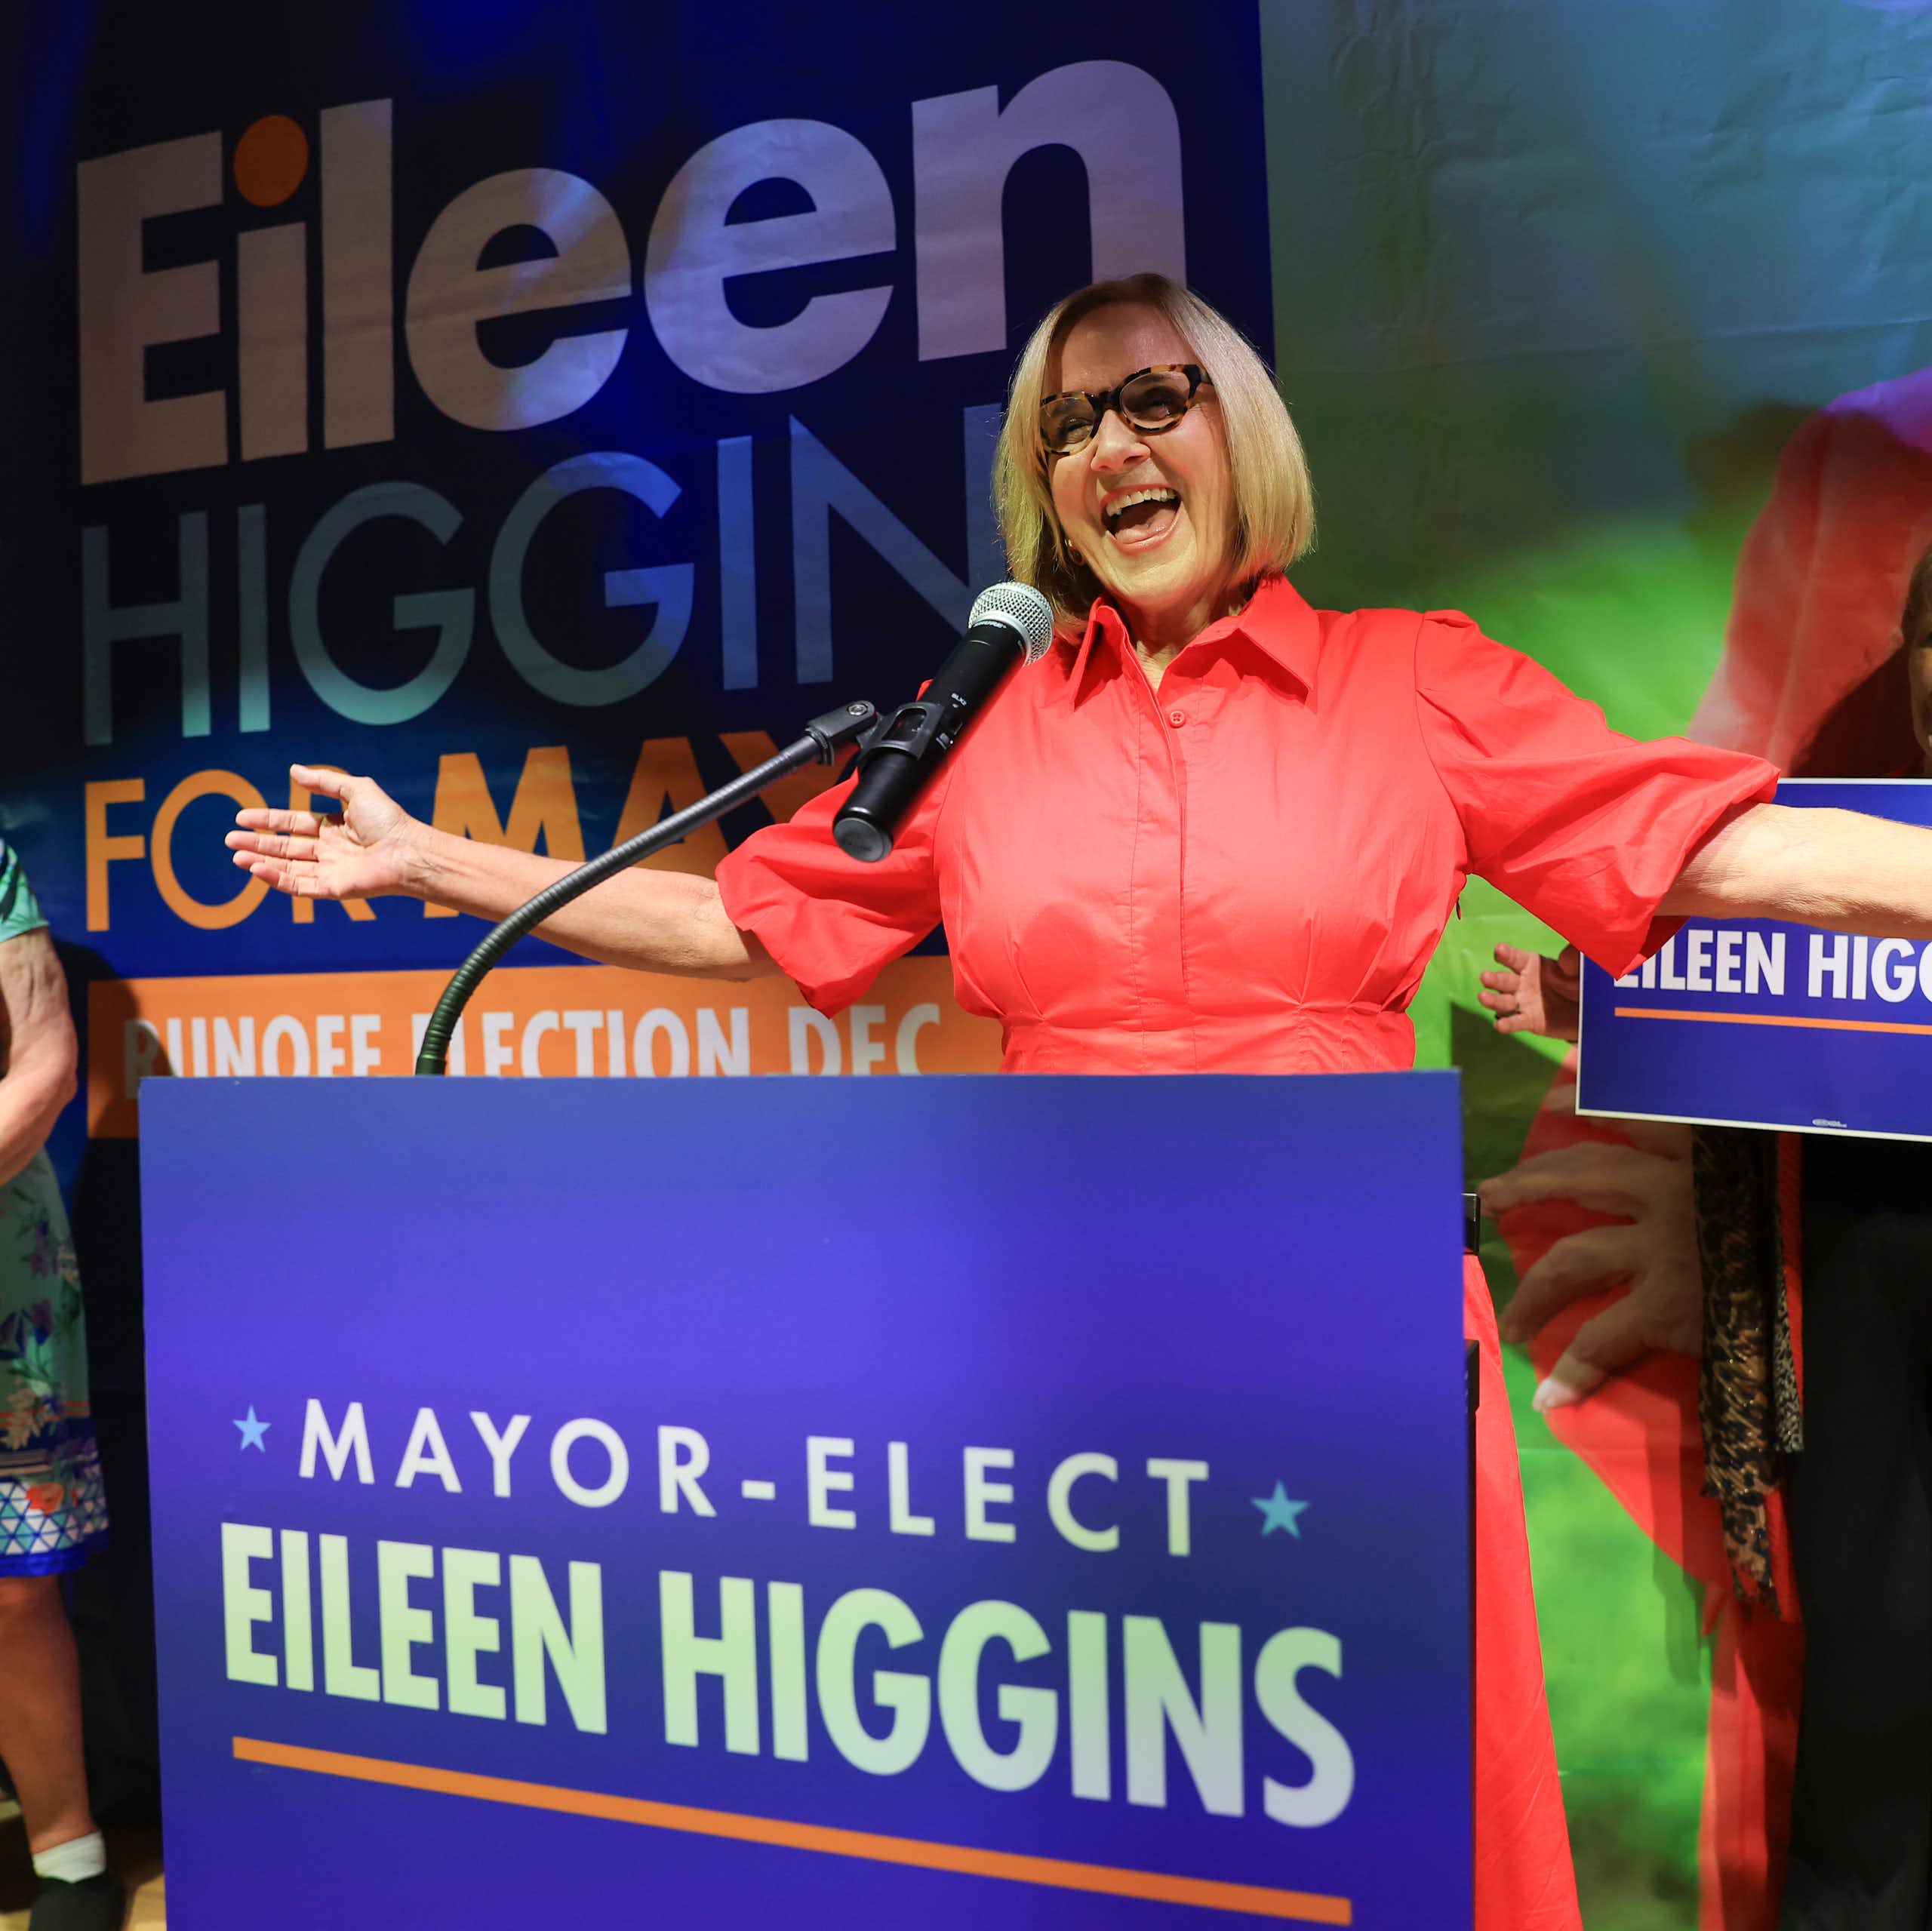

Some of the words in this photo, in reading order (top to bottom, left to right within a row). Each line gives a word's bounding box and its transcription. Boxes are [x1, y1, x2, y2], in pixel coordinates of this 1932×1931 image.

[78, 60, 1187, 486] Eileen
[1614, 929, 1786, 996] ILEEN
[1807, 934, 1932, 1004] HIG
[300, 1398, 1209, 1556] MAYOR-ELECT
[221, 1522, 607, 1734] EILEEN
[660, 1570, 1355, 1828] HIGGINS
